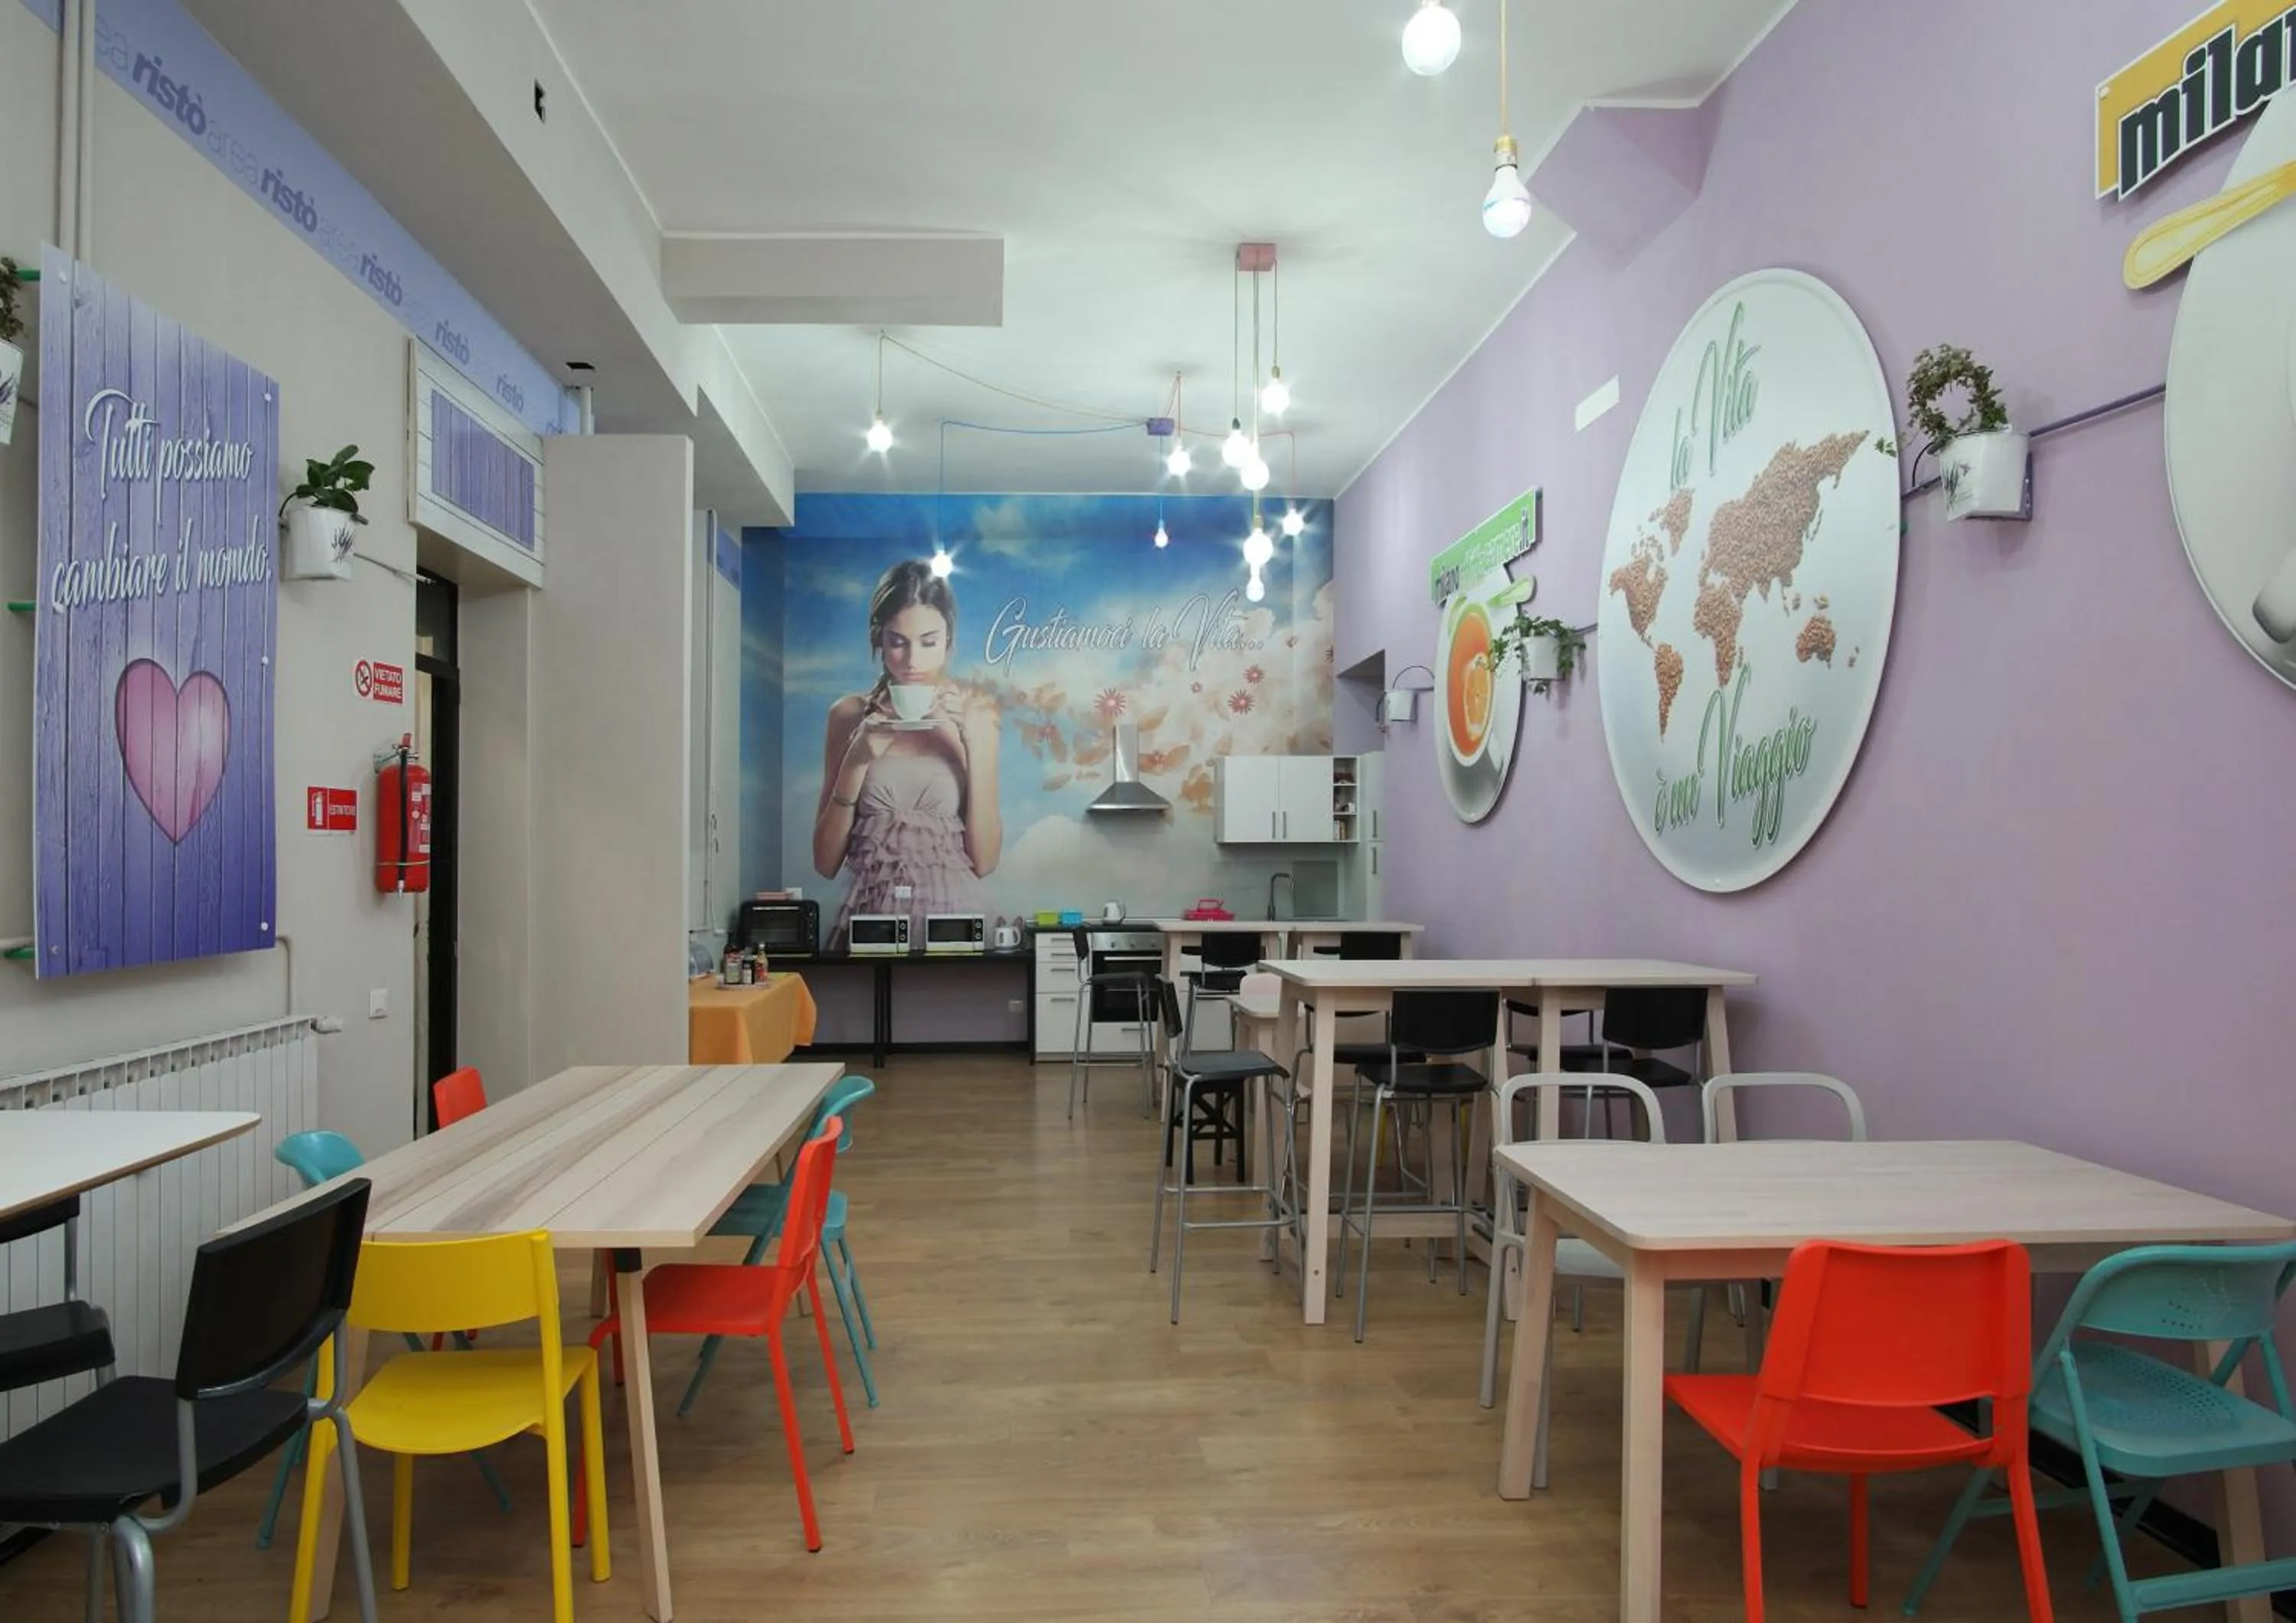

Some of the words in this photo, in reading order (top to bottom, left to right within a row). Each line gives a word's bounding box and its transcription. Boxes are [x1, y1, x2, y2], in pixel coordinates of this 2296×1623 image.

[2118, 2, 2296, 201] mila
[132, 51, 207, 136] ristò
[260, 167, 318, 233] ristò
[359, 252, 403, 306] ristò
[84, 388, 160, 500] Tutti
[155, 427, 254, 529] possiamo
[1689, 299, 1762, 478] Vita
[51, 521, 169, 613] cambiare
[174, 518, 193, 592] il
[373, 667, 402, 683] VIETATO
[373, 683, 402, 699] FUMARE
[984, 596, 1133, 678] Gustiamoci
[1140, 608, 1171, 651] la
[1670, 772, 1701, 830] un
[1697, 662, 1818, 851] Viaggio
